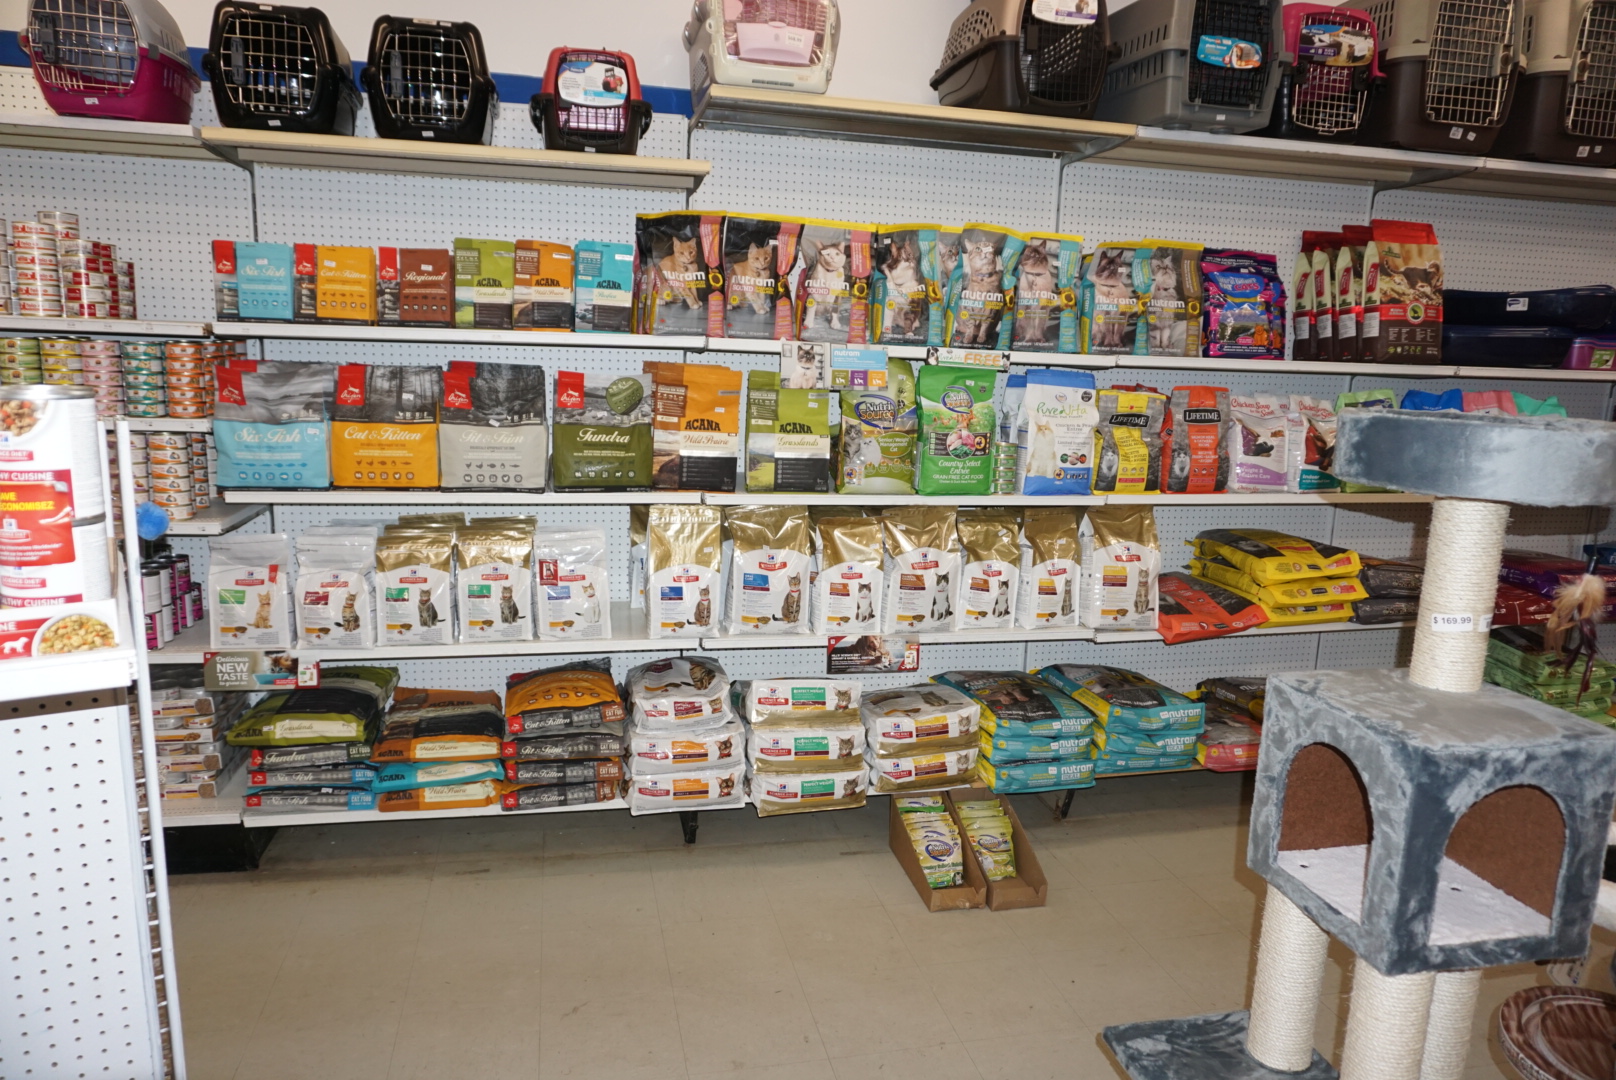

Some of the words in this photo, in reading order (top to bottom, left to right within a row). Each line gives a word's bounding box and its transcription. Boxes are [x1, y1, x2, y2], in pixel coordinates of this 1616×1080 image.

[241, 264, 259, 276] Six
[262, 264, 286, 277] Fish
[320, 269, 334, 277] Cat
[341, 269, 366, 278] Kitten
[403, 271, 447, 282] Regional
[732, 275, 774, 287] nutram
[476, 278, 502, 287] ACANA
[534, 278, 560, 286] ACANA
[596, 280, 622, 290] ACANA
[805, 279, 850, 290] nutram
[1234, 283, 1260, 291] CATS
[476, 289, 506, 297] Grasslands
[534, 288, 548, 296] Wild
[961, 290, 1004, 302] nutram
[1020, 290, 1057, 300] nutram
[962, 300, 984, 308] IDEAL
[1095, 295, 1136, 305] nutram
[1147, 298, 1185, 308] nutram
[834, 349, 860, 357] nutram
[964, 353, 1001, 366] FREE
[950, 392, 969, 400] Nutri
[865, 403, 891, 411] Nutri
[1036, 402, 1087, 415] PureVita
[1231, 398, 1255, 409] Chicken
[1256, 402, 1270, 410] Soup
[860, 409, 895, 420] Source
[1186, 411, 1219, 420] LIFETIME
[685, 418, 721, 432] ACANA
[1112, 415, 1148, 426] LIFETIME
[344, 426, 367, 440] Cat
[369, 430, 377, 440] &
[378, 426, 422, 440] Kitten
[779, 422, 813, 434] ACANA
[234, 427, 262, 443] Six
[266, 427, 300, 443] Fish
[460, 430, 484, 443] Fit
[485, 433, 492, 442] &
[492, 430, 524, 444] Trim
[577, 428, 630, 443] Tundra
[684, 434, 701, 445] Wild
[702, 434, 729, 445] Prairie
[777, 436, 818, 446] Grasslands
[939, 460, 963, 468] Country
[11, 472, 54, 481] CUISINE
[0, 492, 16, 500] AVE
[24, 597, 65, 607] CUISINE
[1434, 616, 1438, 624] $
[1441, 616, 1472, 625] 169.99
[217, 663, 249, 673] NEW
[1216, 688, 1236, 700] nutram
[1169, 708, 1201, 717] nutram
[525, 721, 539, 729] Cat
[545, 718, 570, 727] Kitten
[234, 728, 263, 738] ACANA
[1060, 738, 1090, 747] nutram
[1164, 736, 1196, 745] nutram
[540, 745, 562, 753] Trim
[264, 752, 306, 764] Tundra
[518, 770, 532, 778] Cat
[538, 768, 563, 777] Kitten
[1061, 764, 1094, 774] nutram
[273, 773, 288, 781] Six
[292, 772, 314, 780] Fish
[378, 774, 405, 783] ACANA
[267, 796, 282, 805] Six
[286, 796, 309, 805] Fish
[540, 794, 565, 802] Kitten
